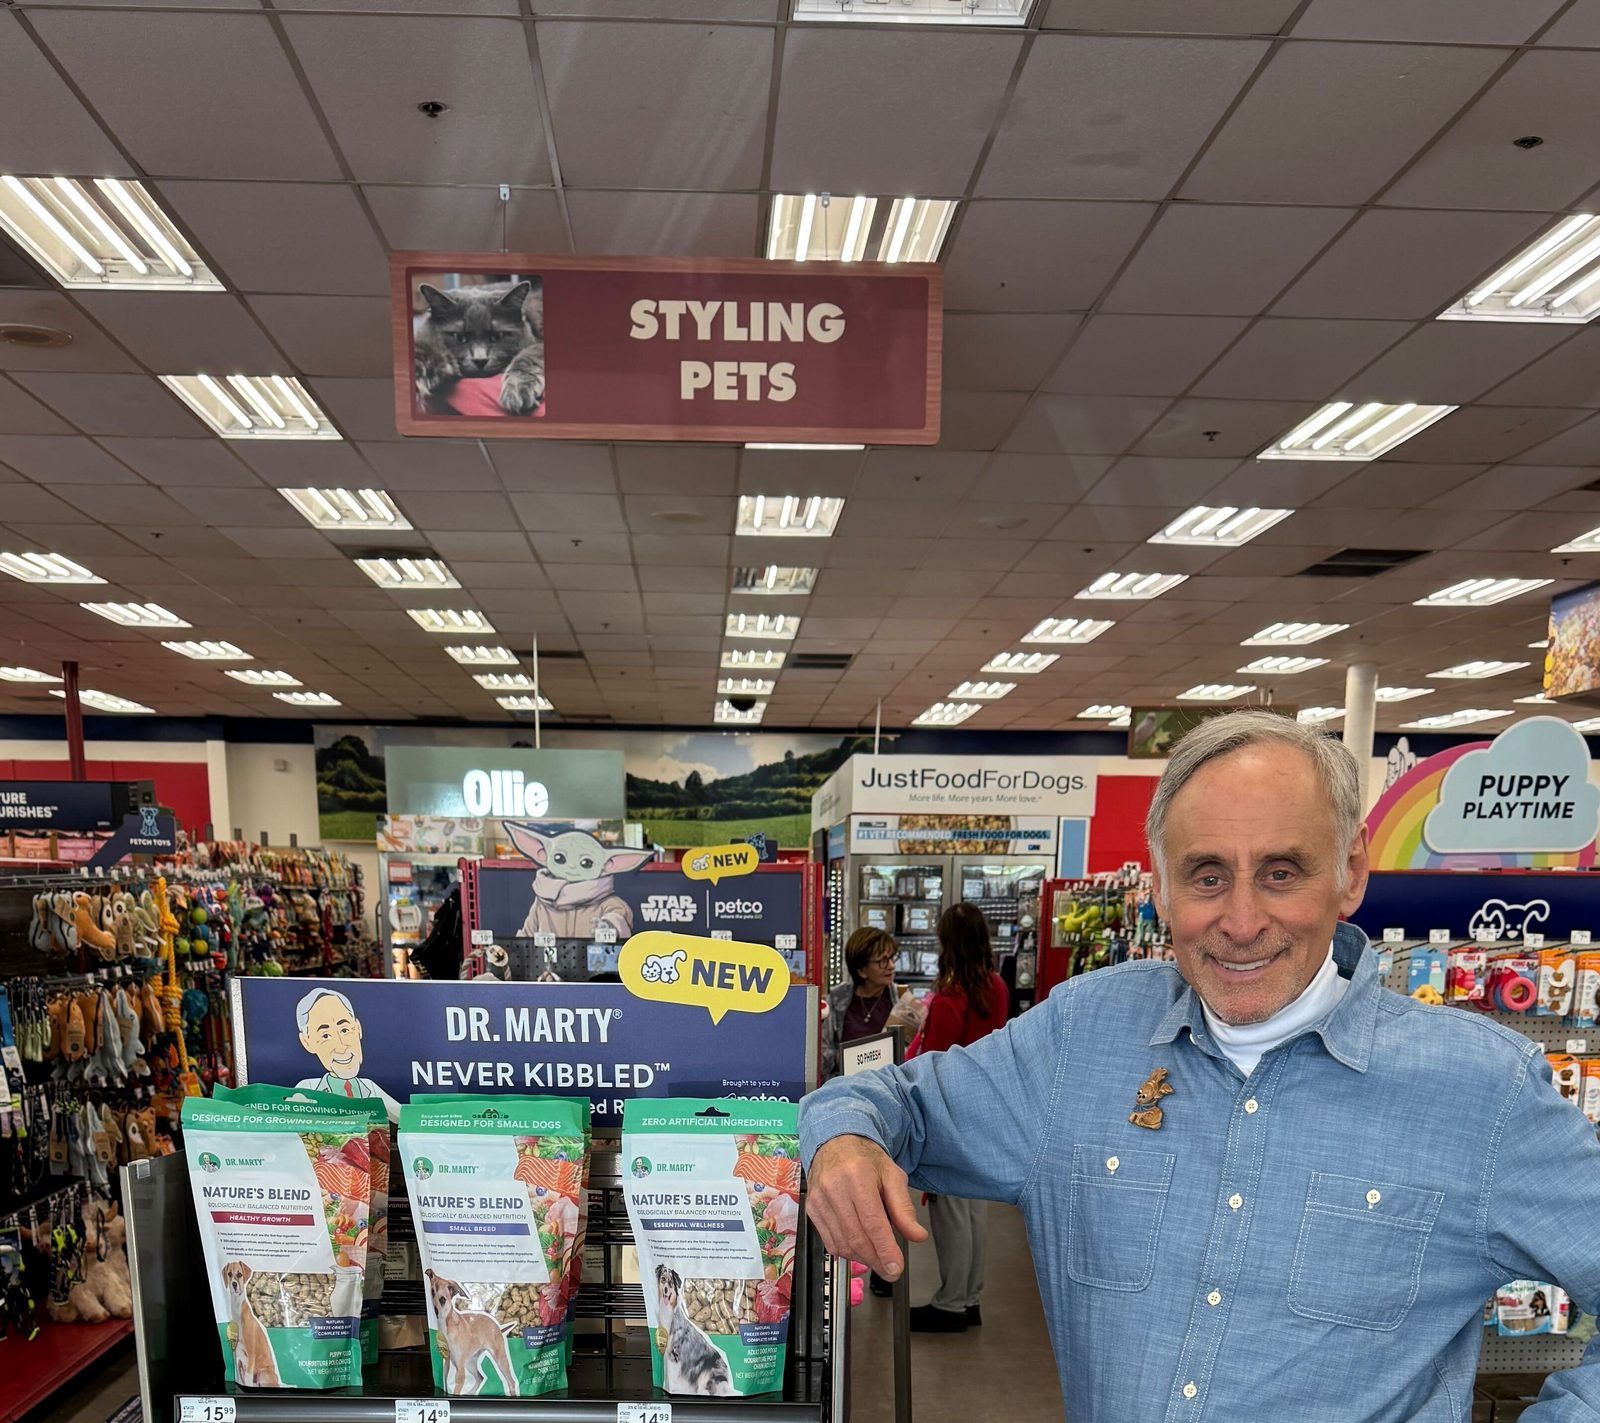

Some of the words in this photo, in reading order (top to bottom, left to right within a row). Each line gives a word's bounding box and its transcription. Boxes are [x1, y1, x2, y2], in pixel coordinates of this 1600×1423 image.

[629, 299, 846, 343] STYLING
[680, 360, 797, 402] PETS
[1479, 775, 1570, 797] PUPPY
[463, 770, 549, 817] Ollie
[909, 793, 930, 802] More
[948, 793, 969, 802] More
[996, 794, 1017, 803] More
[1463, 802, 1575, 819] PLAYTIME
[952, 830, 979, 840] FRESH
[980, 830, 1004, 840] FOOD
[1005, 830, 1021, 840] FOR
[130, 838, 152, 847] FETCH
[153, 839, 171, 847] TOYS
[713, 852, 749, 868] NEW
[641, 895, 697, 909] STAR
[715, 898, 763, 918] petco
[641, 907, 697, 922] WARS
[691, 958, 774, 993] NEW
[446, 1006, 500, 1042] DR.
[856, 1052, 864, 1065] SO
[411, 1061, 515, 1087] NEVER
[525, 1062, 670, 1088] KIBBLED™
[722, 1079, 749, 1088] Brought
[772, 1079, 780, 1088] by
[272, 1104, 291, 1112] FOR
[293, 1106, 337, 1115] GROWING
[191, 1113, 241, 1123] DESIGNED
[243, 1115, 263, 1124] FOR
[265, 1117, 312, 1125] GROWING
[420, 1119, 470, 1128] DESIGNED
[474, 1120, 494, 1128] FOR
[497, 1120, 529, 1129] SMALL
[532, 1121, 561, 1129] DOGS
[642, 1118, 666, 1126] ZERO
[668, 1118, 718, 1126] ARTIFICIAL
[721, 1118, 783, 1127] INGREDIENTS
[202, 1186, 265, 1200] NATURE'S
[269, 1189, 311, 1201] BLEND
[632, 1194, 691, 1206] NATURE'S
[695, 1195, 738, 1206] BLEND
[480, 1197, 524, 1209] BLEND
